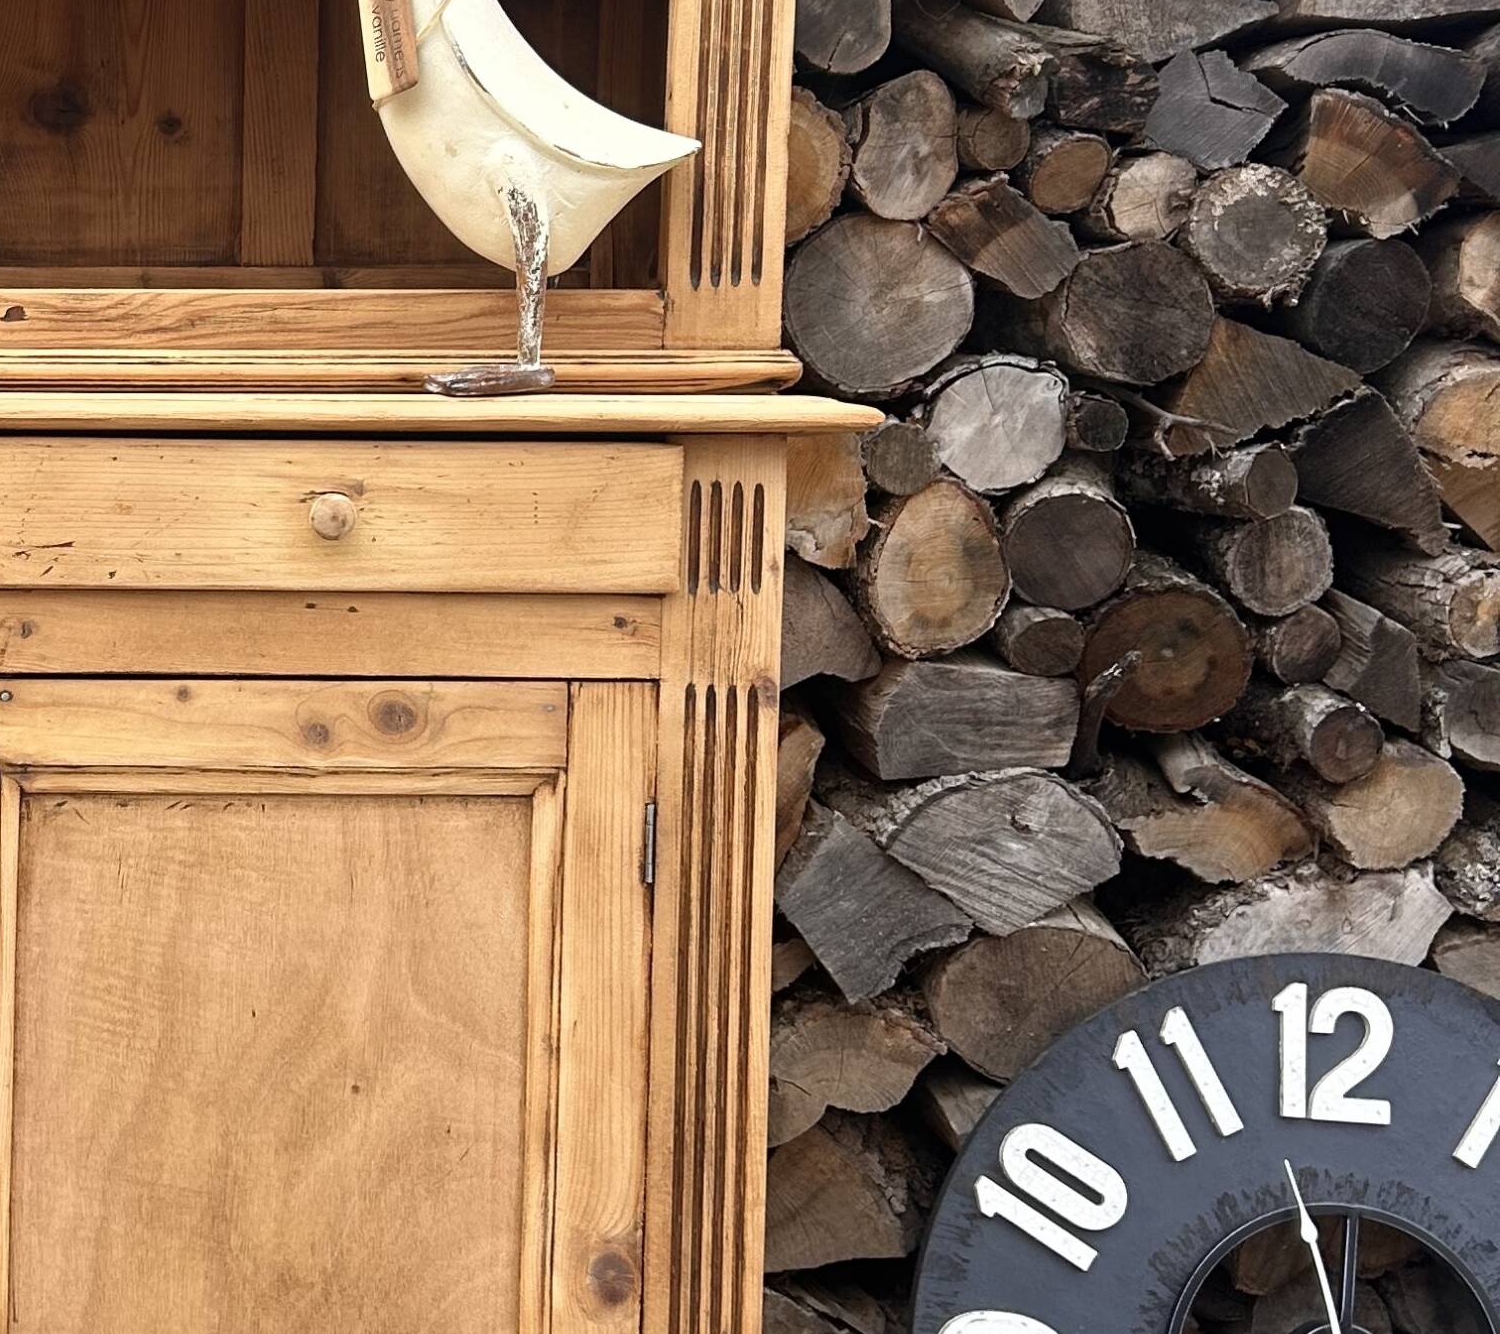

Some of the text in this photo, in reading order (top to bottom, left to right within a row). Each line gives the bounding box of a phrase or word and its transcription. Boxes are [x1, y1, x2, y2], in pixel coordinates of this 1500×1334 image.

[371, 4, 386, 63] vanille
[391, 8, 404, 61] name
[1112, 1006, 1244, 1162] 11
[1271, 981, 1395, 1125] 12
[973, 1122, 1128, 1273] 10
